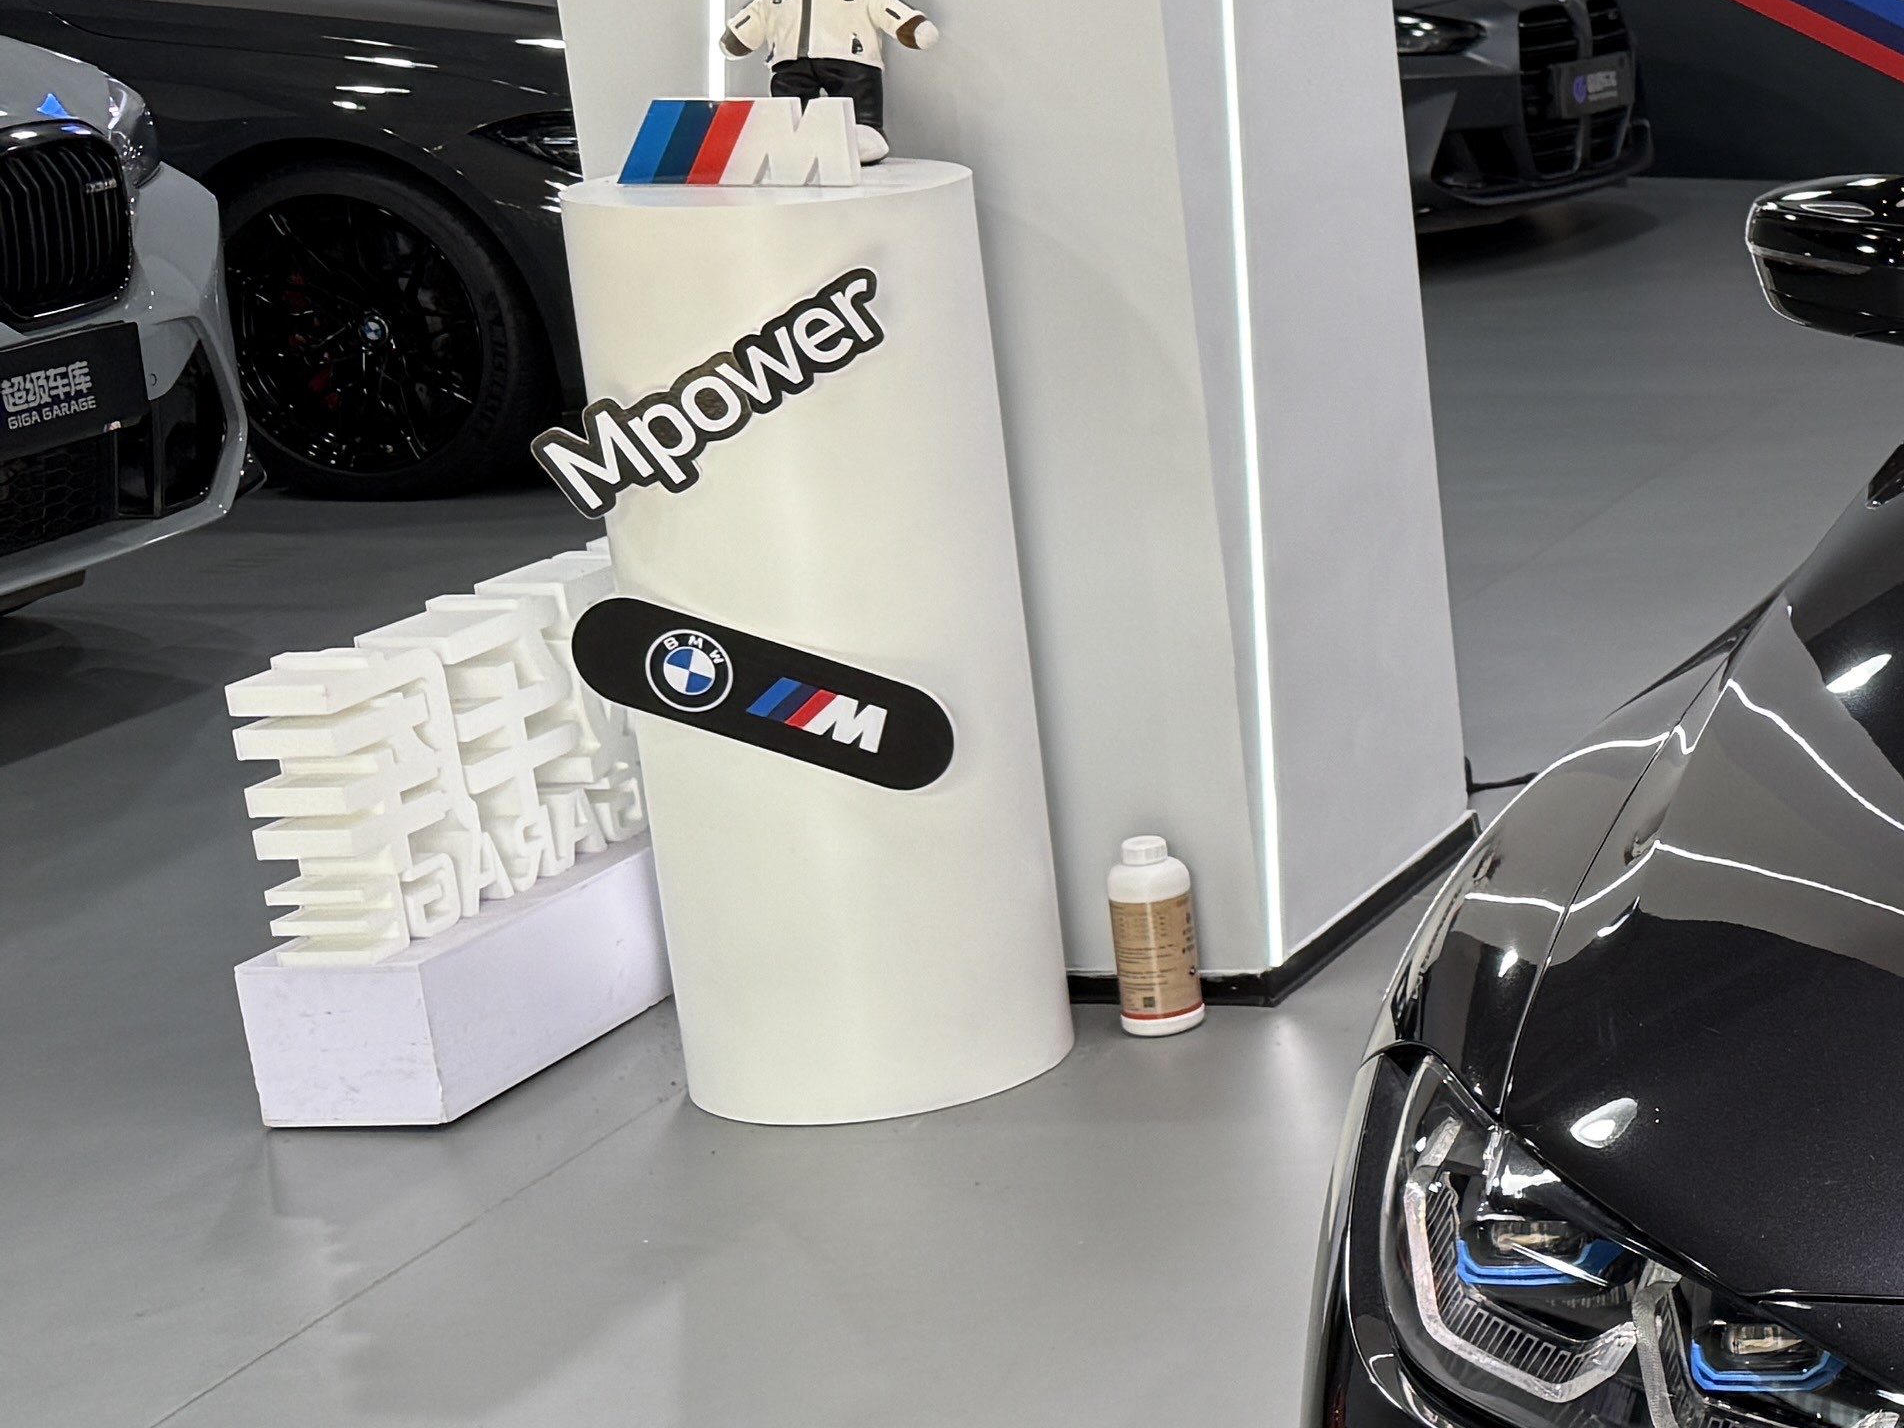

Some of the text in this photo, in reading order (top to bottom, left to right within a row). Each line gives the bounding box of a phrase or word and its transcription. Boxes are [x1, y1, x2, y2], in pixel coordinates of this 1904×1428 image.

[1, 360, 93, 413] 超级车库
[543, 275, 879, 511] Mpower
[7, 395, 97, 430] GIGA GARAGE
[663, 635, 725, 665] BMW
